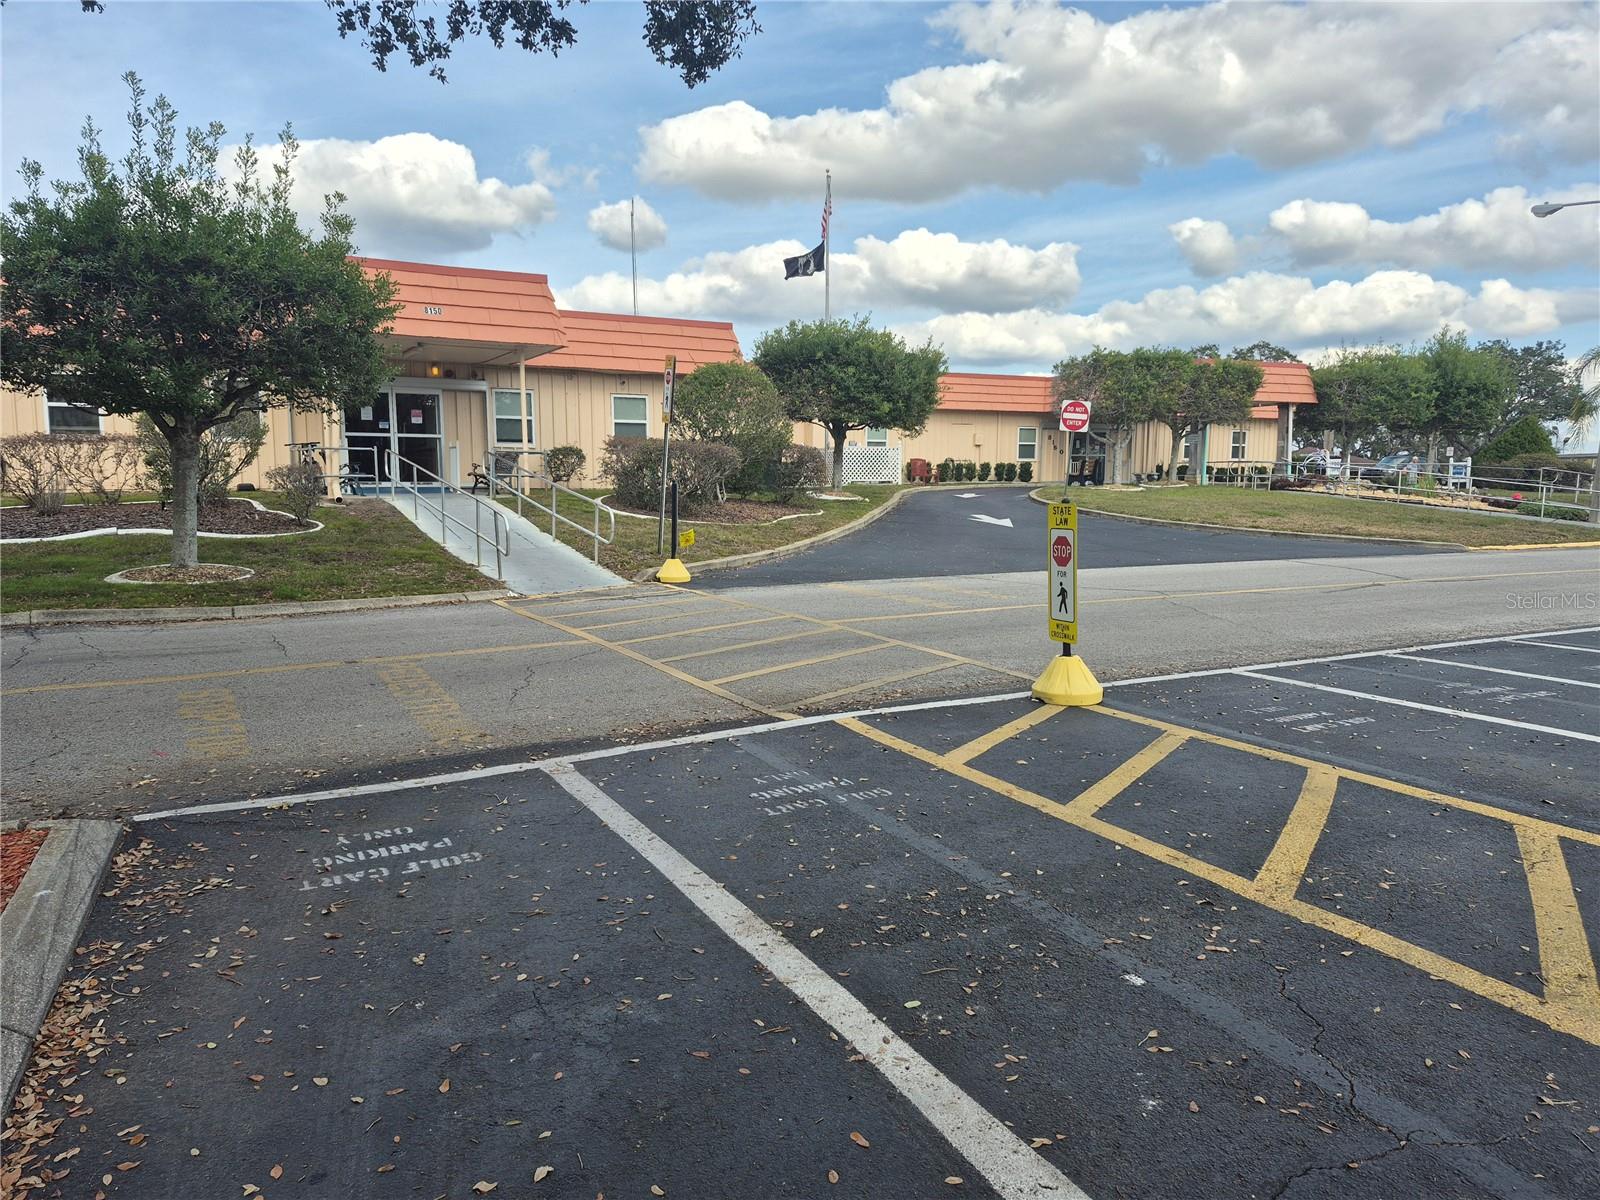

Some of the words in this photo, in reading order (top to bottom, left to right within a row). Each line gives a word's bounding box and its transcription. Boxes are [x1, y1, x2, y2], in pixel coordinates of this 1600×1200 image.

[424, 306, 442, 315] 8150
[1052, 506, 1072, 516] STATE
[1055, 517, 1069, 526] LAW
[1053, 544, 1072, 558] STOP
[1056, 570, 1067, 578] FOR
[1055, 623, 1070, 632] WITHIN
[1050, 630, 1075, 641] CROSSWALK
[749, 778, 854, 799] PARKING
[835, 787, 893, 804] GOLF
[763, 798, 829, 816] CART
[335, 826, 414, 851] ONLY
[312, 837, 453, 870] PARKING
[400, 851, 484, 875] GOLF
[298, 866, 391, 892] CART
